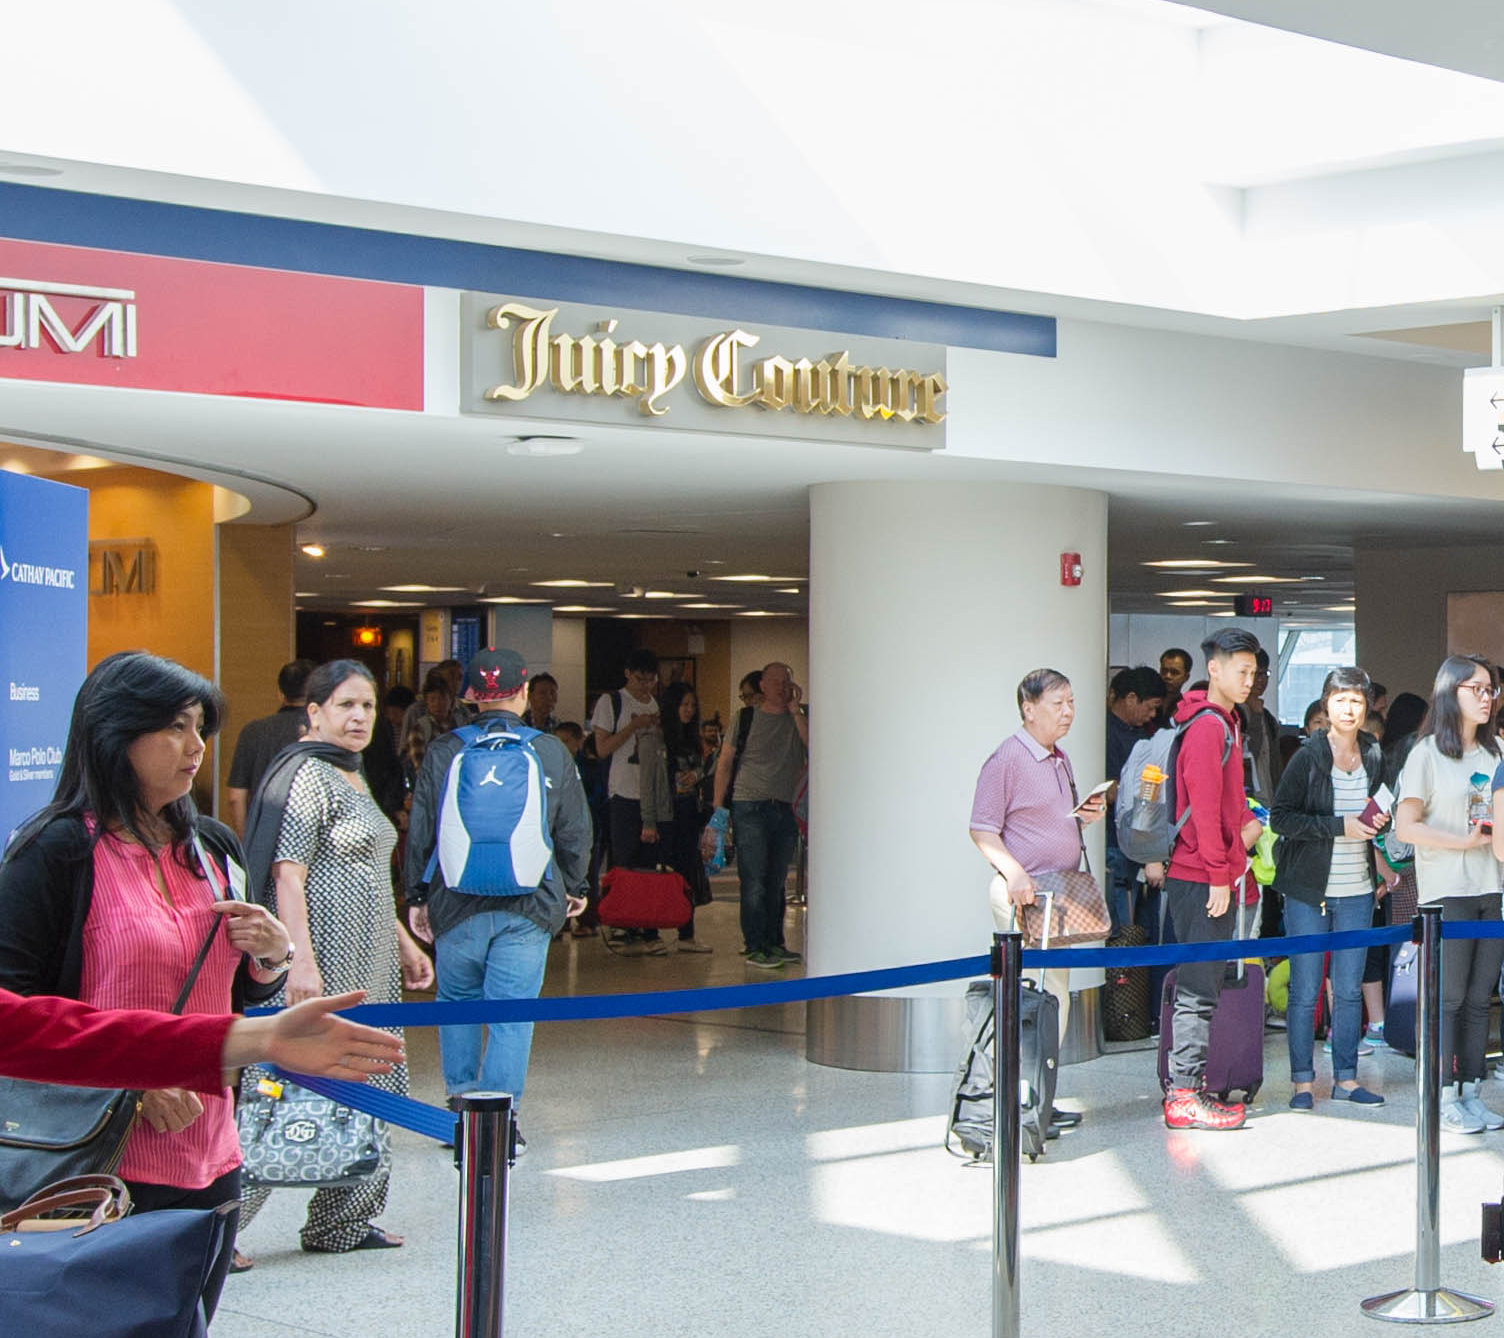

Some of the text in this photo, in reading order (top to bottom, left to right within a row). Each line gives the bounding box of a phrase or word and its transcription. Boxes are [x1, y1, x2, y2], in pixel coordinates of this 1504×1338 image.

[484, 301, 949, 424] Juicy Couture
[11, 563, 76, 589] CATHAY PACIFIC
[9, 682, 40, 702] Business
[9, 746, 63, 766] Marco Polo Club
